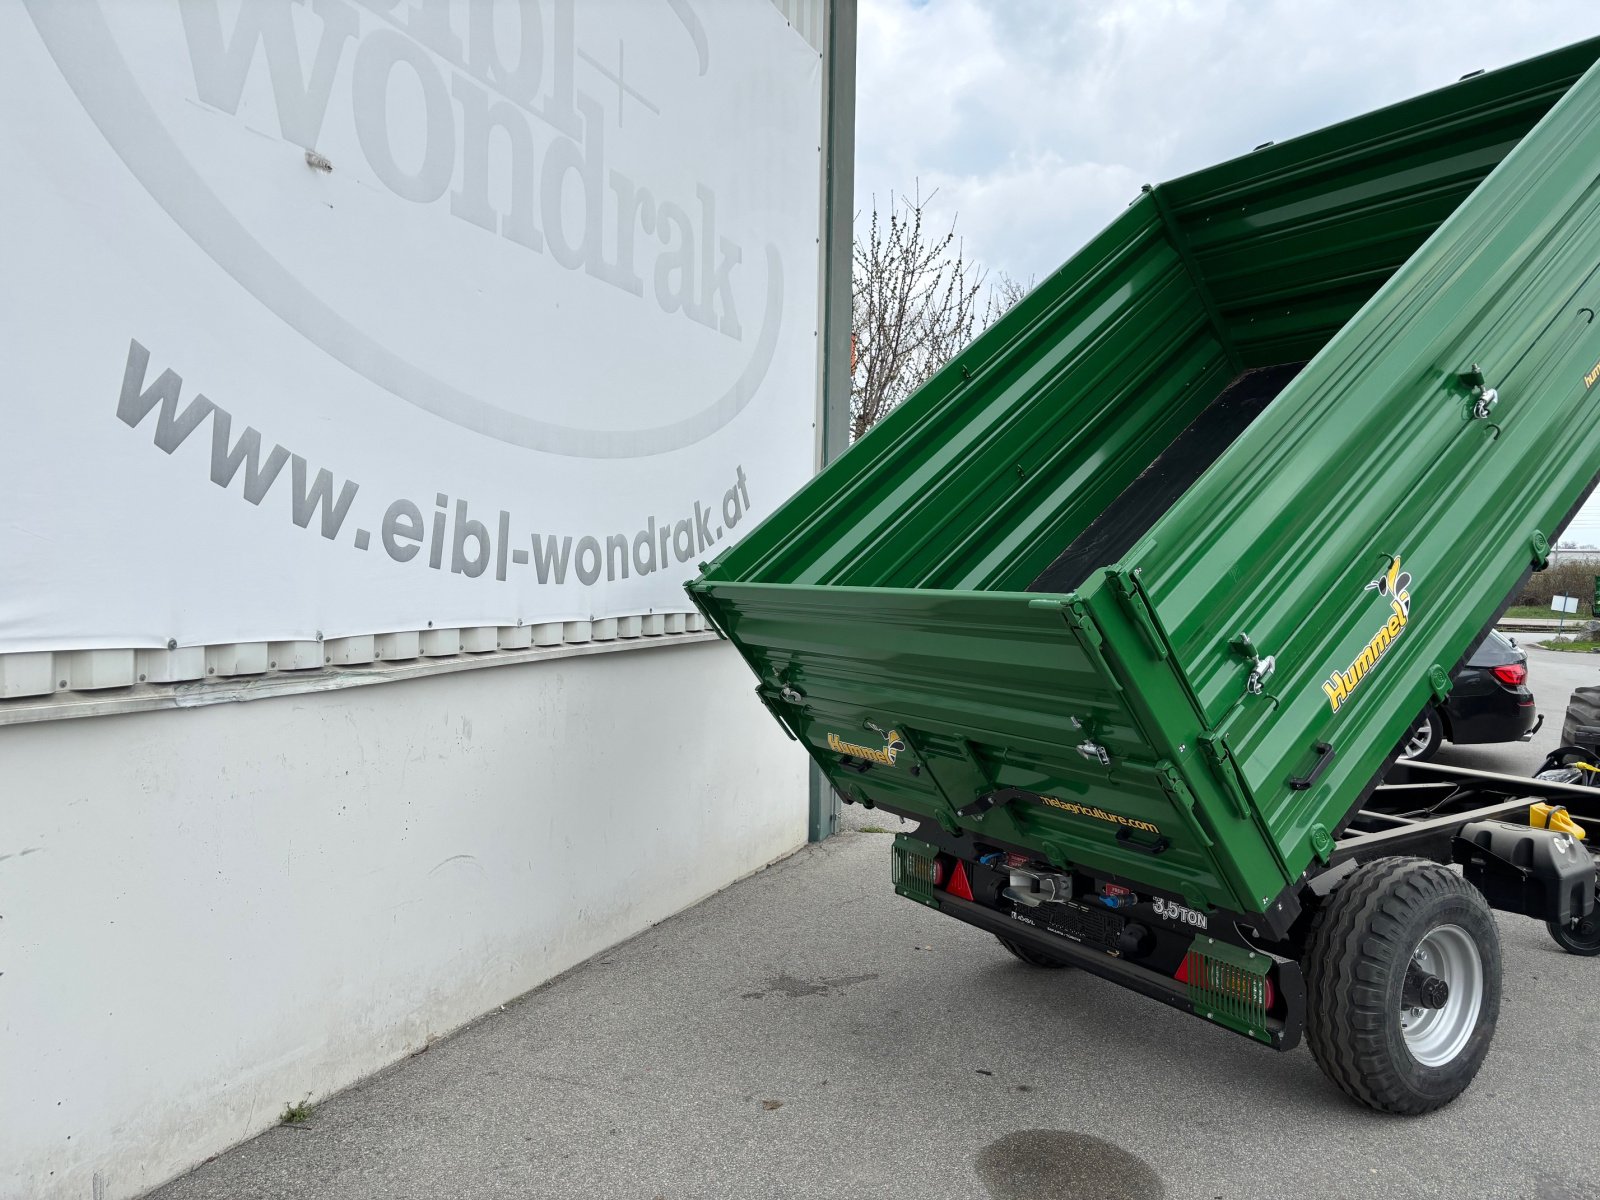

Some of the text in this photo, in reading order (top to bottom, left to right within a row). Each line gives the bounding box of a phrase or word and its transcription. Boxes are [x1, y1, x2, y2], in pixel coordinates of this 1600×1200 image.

[115, 338, 751, 587] www.eibl-wondrak.at
[1322, 599, 1408, 714] Hummel
[827, 732, 896, 768] Hummel
